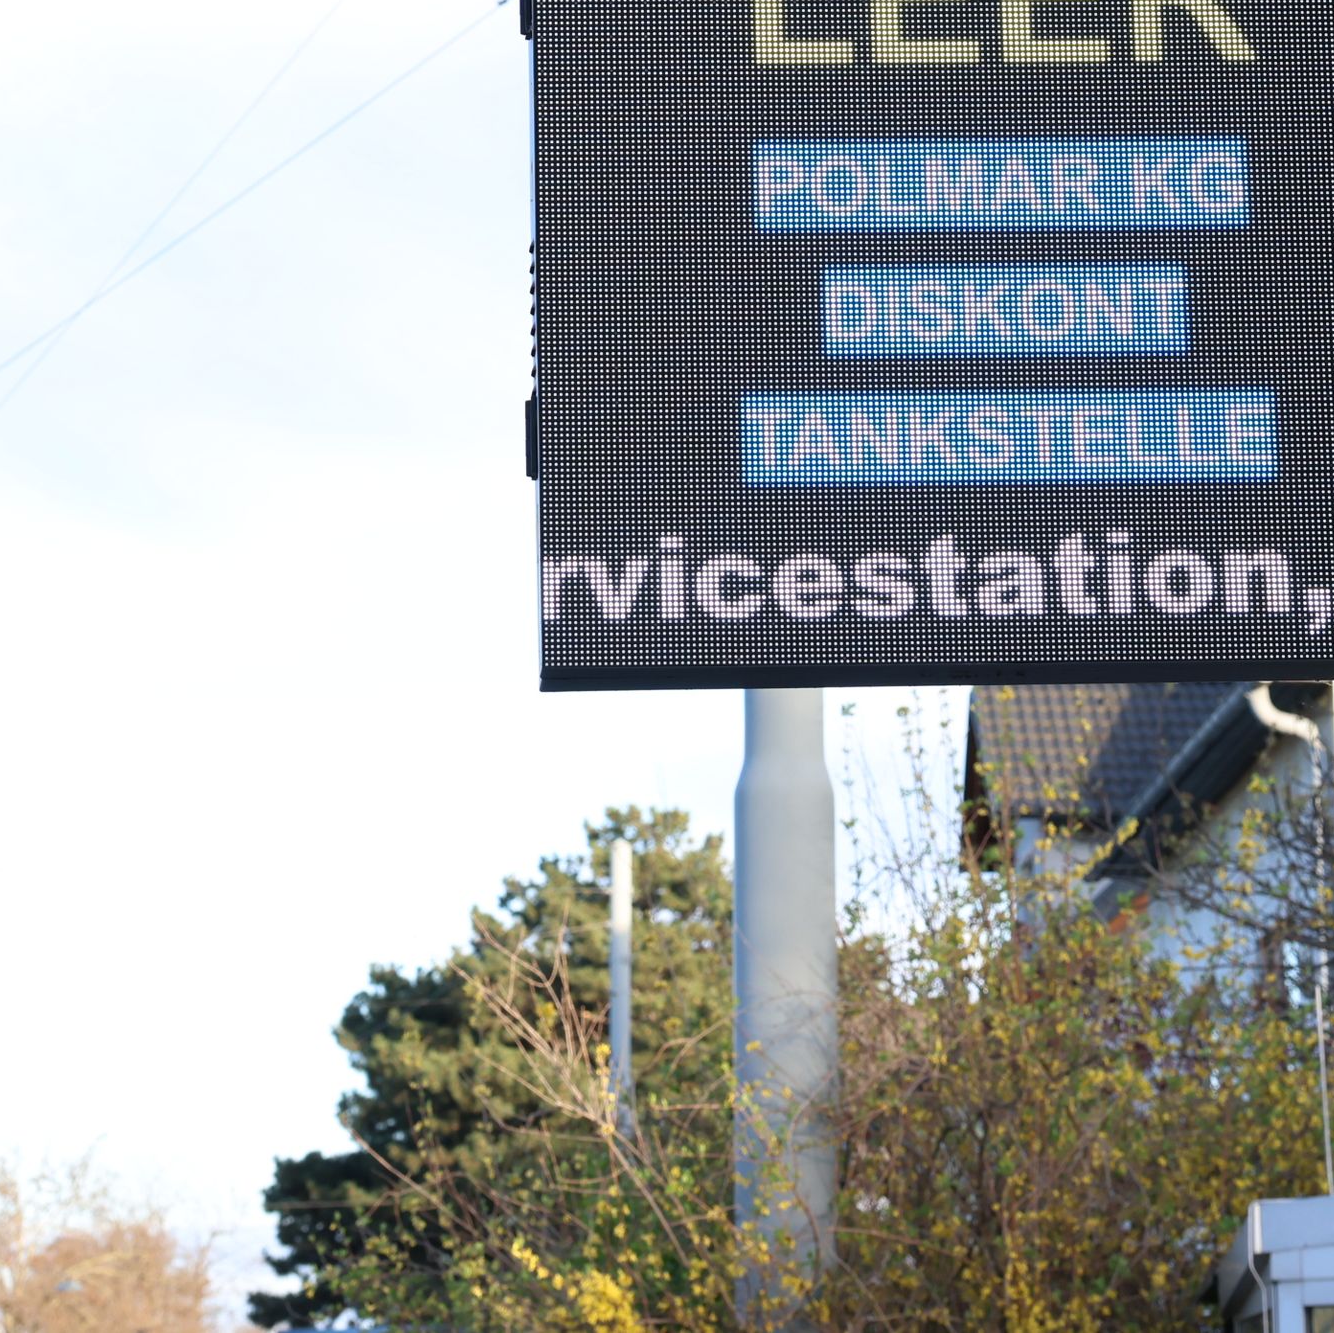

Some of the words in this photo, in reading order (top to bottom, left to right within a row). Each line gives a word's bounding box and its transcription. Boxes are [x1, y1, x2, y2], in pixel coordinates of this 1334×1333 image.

[755, 157, 1102, 217] POLMAR
[1133, 152, 1248, 214] KG
[826, 278, 1187, 342] DISKONT
[747, 403, 1272, 469] TANKSTELLE
[542, 532, 1330, 634] rvicestation,
